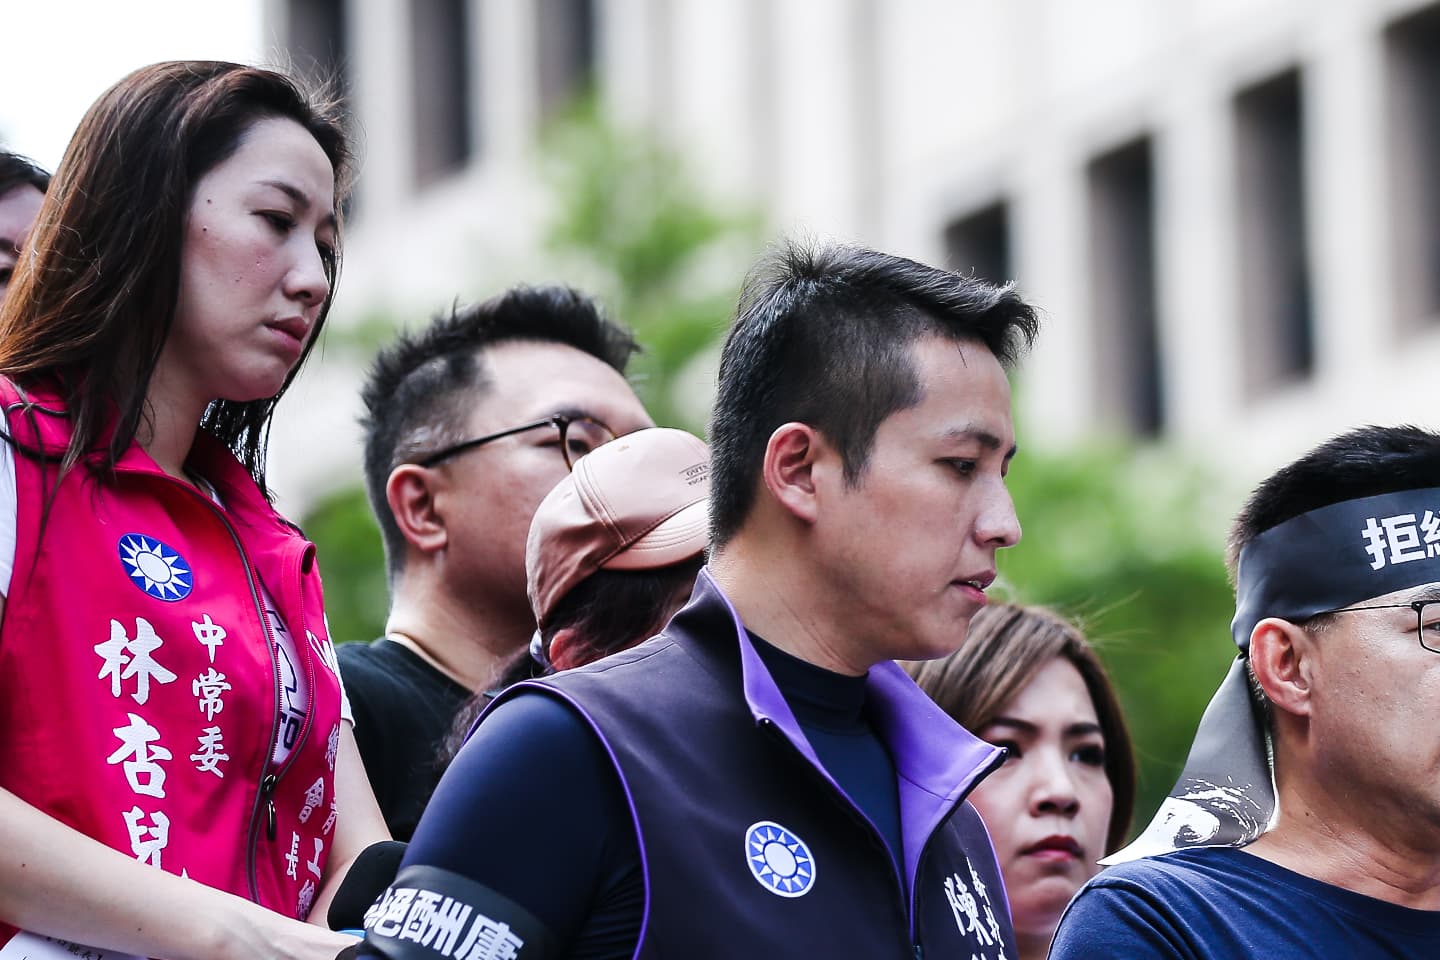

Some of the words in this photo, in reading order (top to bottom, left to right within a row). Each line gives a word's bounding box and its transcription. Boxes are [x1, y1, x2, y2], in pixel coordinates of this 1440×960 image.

[94, 616, 190, 880] 林杏兒
[190, 613, 232, 779] 中常委
